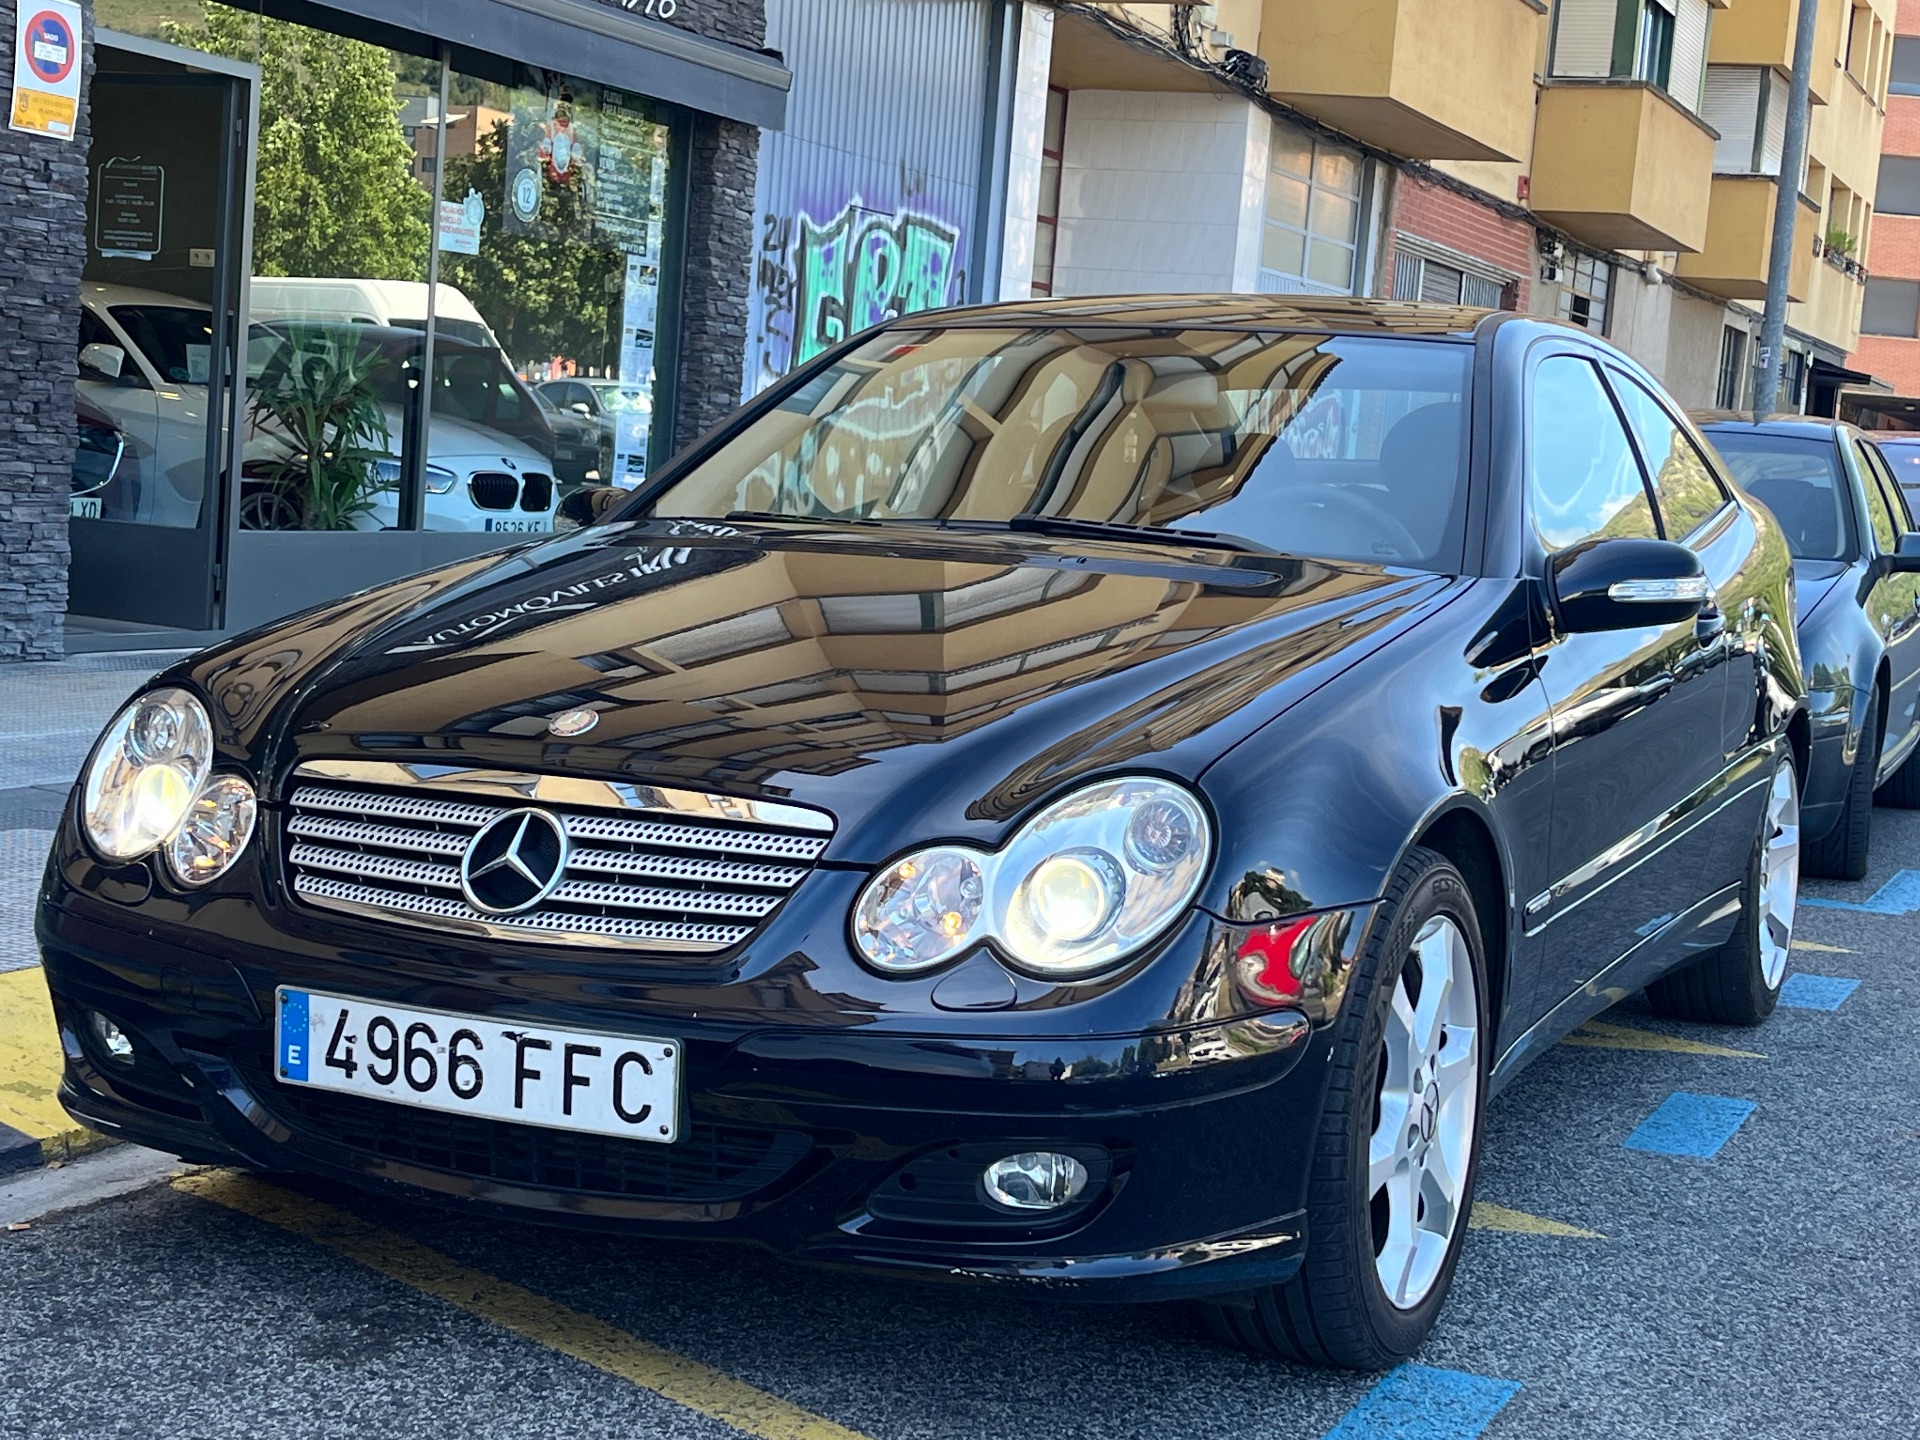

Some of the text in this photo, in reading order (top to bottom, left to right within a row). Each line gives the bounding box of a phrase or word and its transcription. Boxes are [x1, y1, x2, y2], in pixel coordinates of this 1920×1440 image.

[287, 1044, 301, 1065] E
[324, 1008, 652, 1124] 4966 FFC
